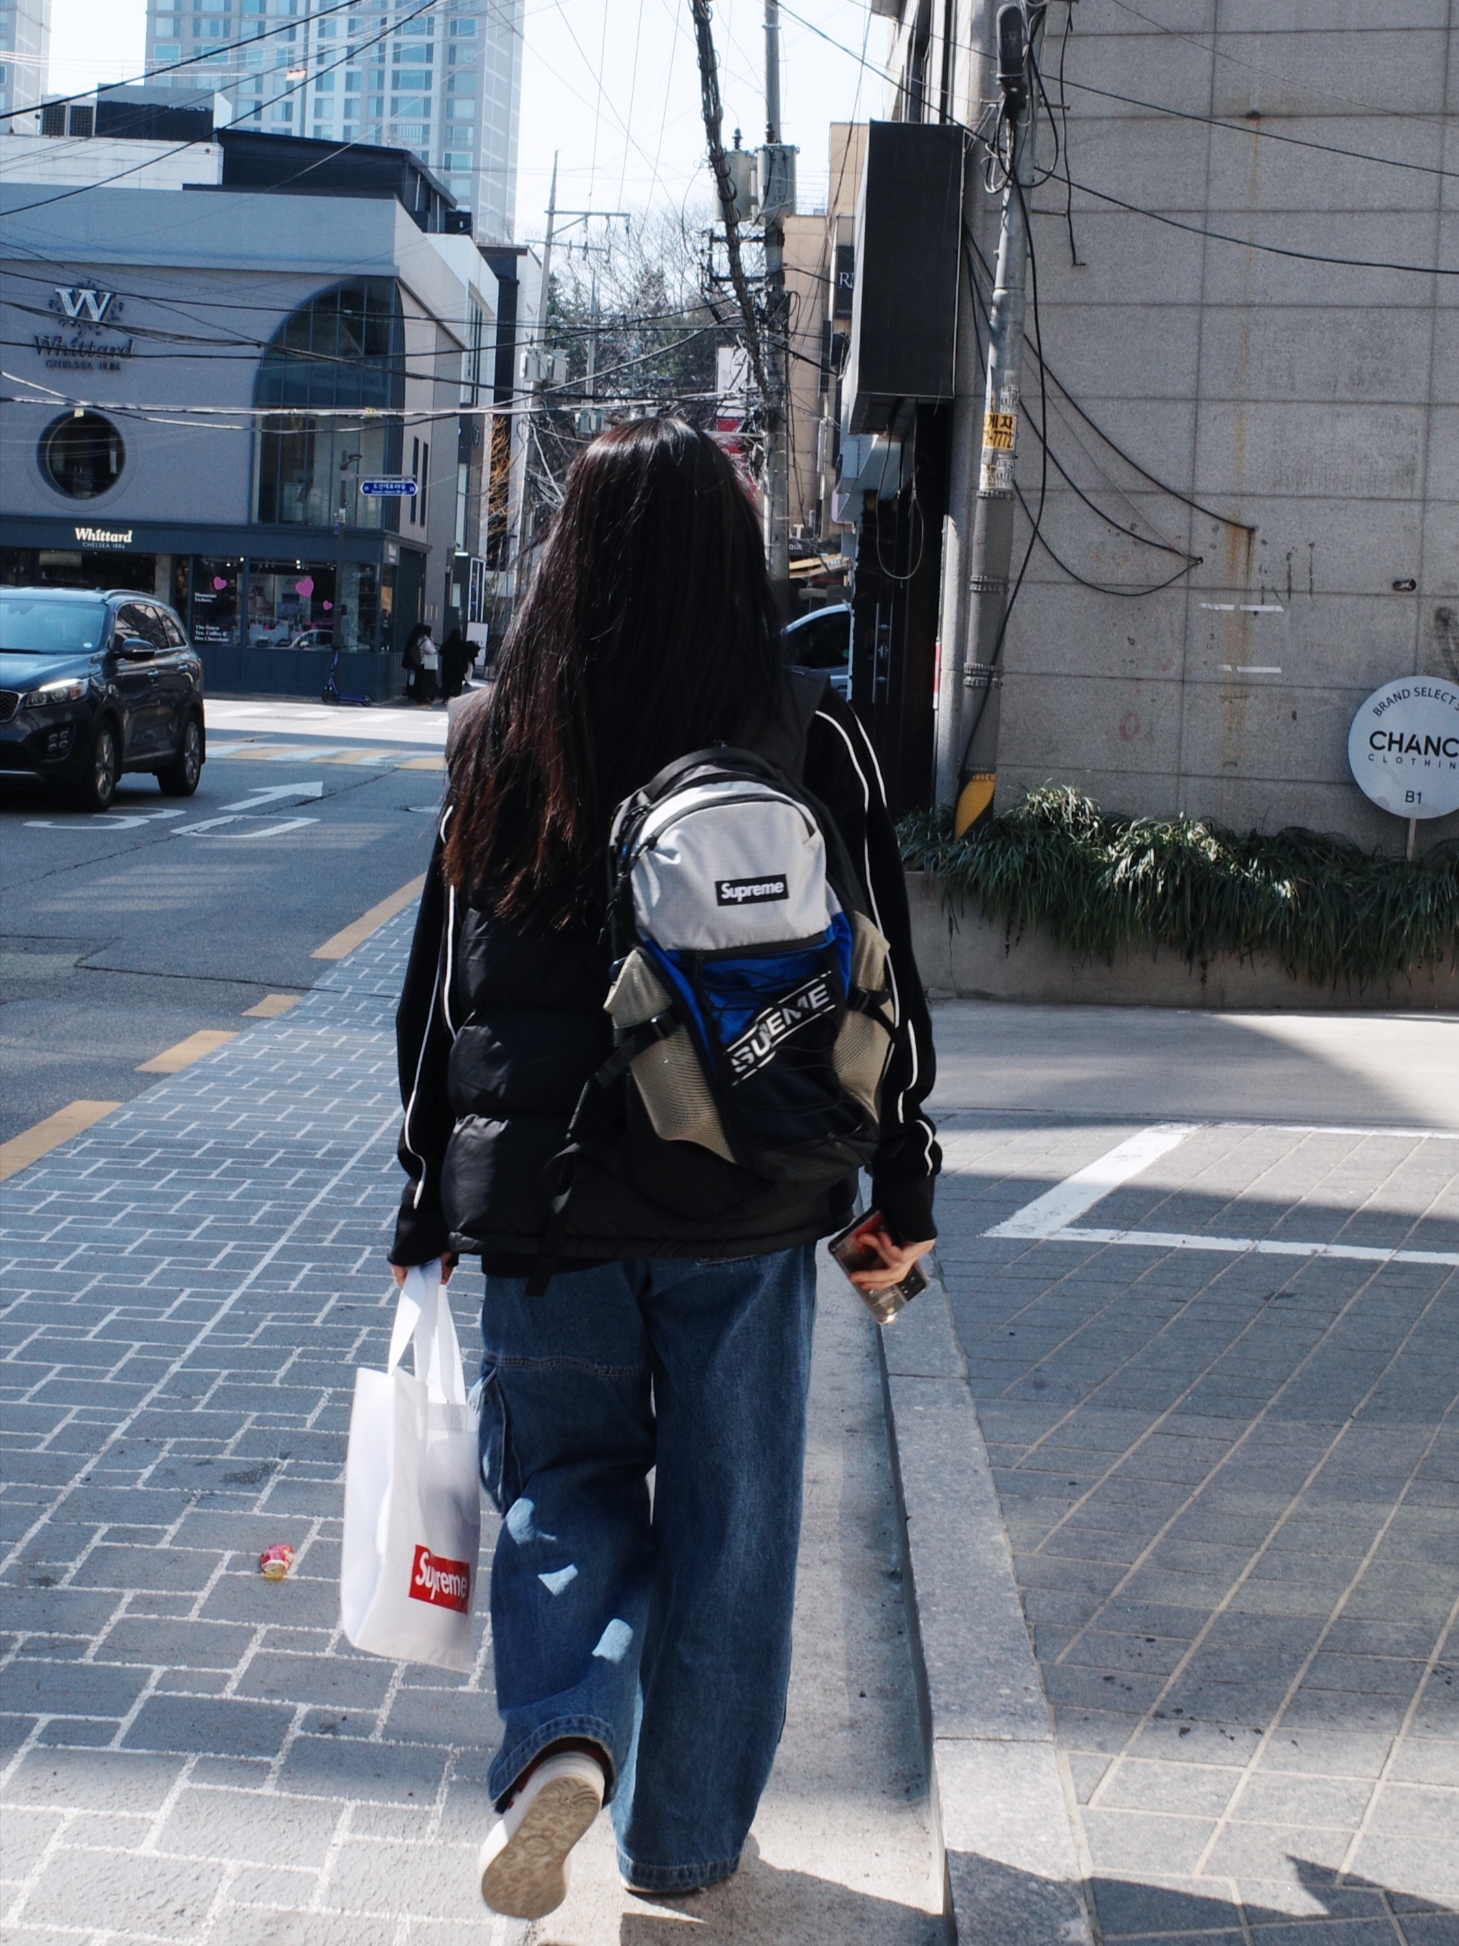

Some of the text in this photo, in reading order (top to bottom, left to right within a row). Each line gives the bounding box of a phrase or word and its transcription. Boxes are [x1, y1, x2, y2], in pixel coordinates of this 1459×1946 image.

[55, 287, 116, 324] W
[34, 335, 134, 360] Whittard
[75, 527, 133, 543] Whittard
[1372, 686, 1457, 717] BRAND SELECT
[1369, 730, 1459, 758] CHANC
[1367, 753, 1457, 770] CLOTHIN
[1404, 790, 1422, 804] B1
[721, 881, 785, 903] Supreme
[415, 1551, 467, 1600] Supreme
